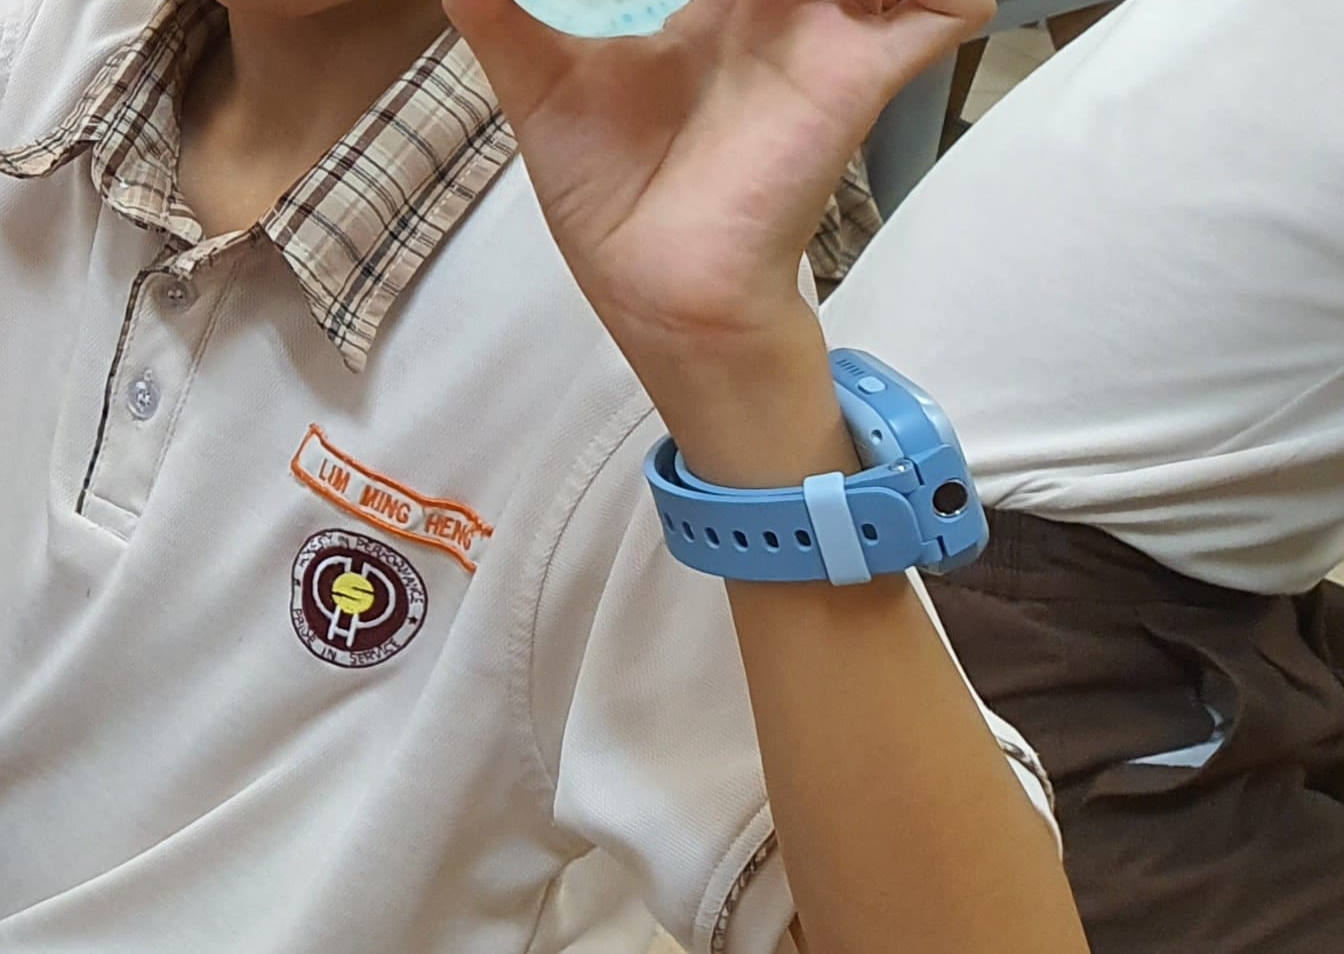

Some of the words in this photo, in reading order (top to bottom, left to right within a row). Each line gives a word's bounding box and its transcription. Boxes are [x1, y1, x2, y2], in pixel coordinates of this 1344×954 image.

[319, 459, 350, 494] LIM
[359, 484, 410, 525] MING
[425, 511, 473, 550] HENG
[321, 646, 338, 661] IN
[349, 638, 401, 665] SERVICE
